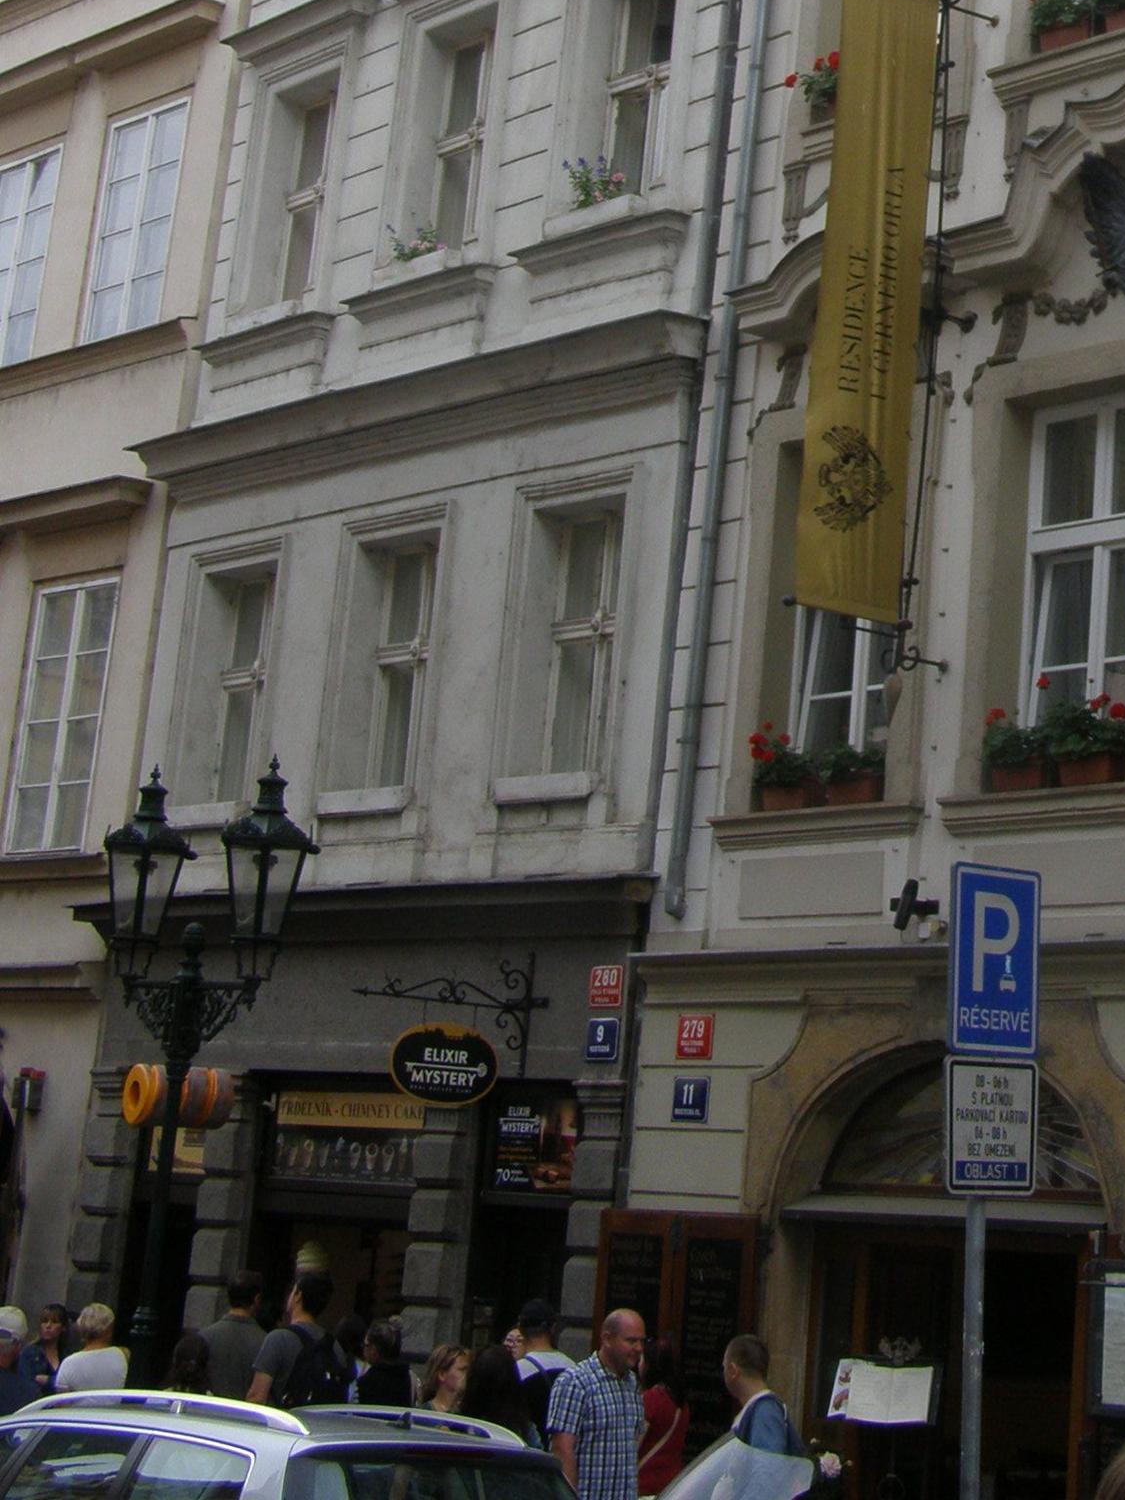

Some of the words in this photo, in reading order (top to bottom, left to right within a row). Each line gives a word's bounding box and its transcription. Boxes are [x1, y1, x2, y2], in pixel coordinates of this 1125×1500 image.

[883, 165, 904, 237] ORLA
[837, 245, 870, 394] RESIDENCE
[972, 890, 1020, 992] P
[594, 969, 618, 987] 280
[960, 1004, 1031, 1033] RÉSERVÉ
[596, 1025, 605, 1042] 9
[682, 1020, 706, 1038] 279
[424, 1047, 469, 1064] ELIXIR
[411, 1069, 477, 1087] MYSTERY
[683, 1083, 694, 1105] 11
[980, 1091, 1014, 1106] PLATNOU
[341, 1102, 391, 1119] CHIMNEY
[508, 1106, 531, 1116] ELIXIR
[999, 1108, 1029, 1124] KARTOU
[501, 1122, 534, 1133] MYSTERY
[967, 1142, 981, 1156] BEZ
[964, 1163, 1008, 1180] OBLAST
[1014, 1164, 1019, 1179] 1
